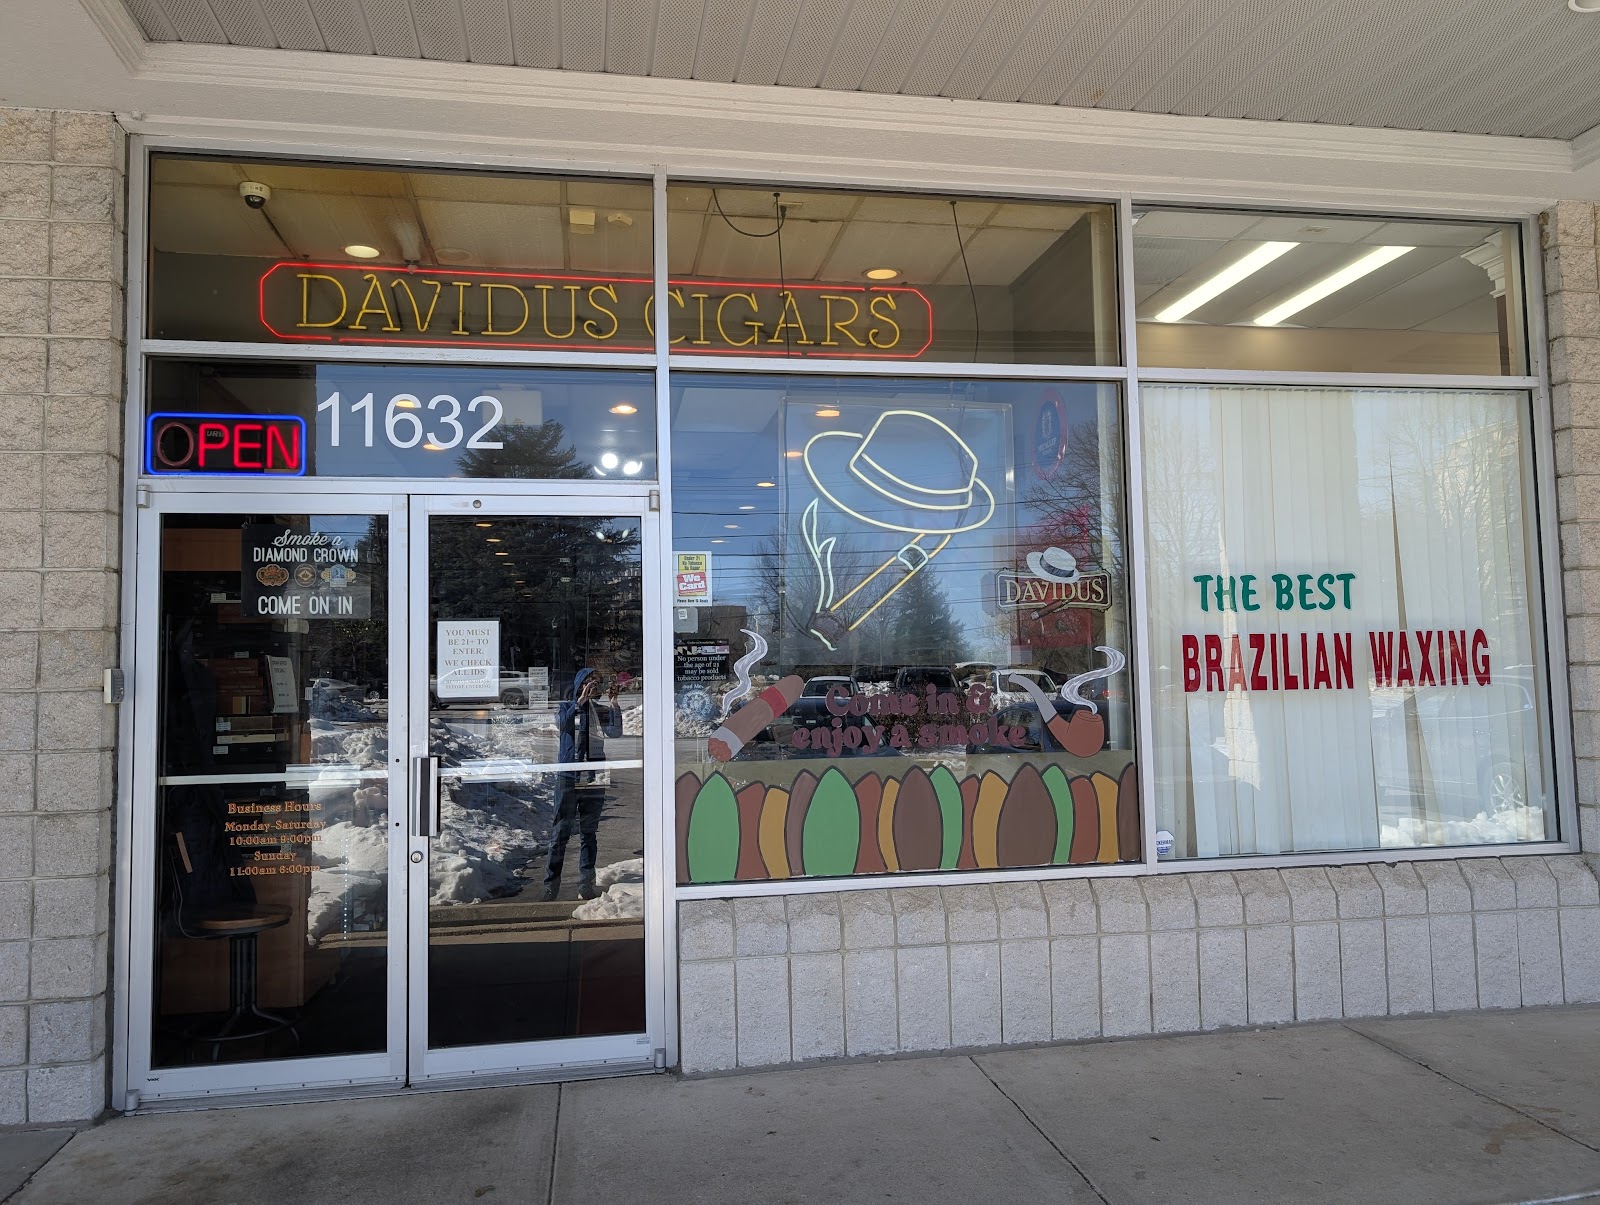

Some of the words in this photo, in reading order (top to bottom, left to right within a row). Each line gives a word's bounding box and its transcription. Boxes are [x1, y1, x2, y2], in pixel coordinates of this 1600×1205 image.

[295, 273, 619, 339] DAVIDUS
[644, 288, 901, 349] CIGARS
[317, 391, 504, 450] 11632
[156, 422, 299, 468] OPEN
[271, 529, 329, 547] Smoke
[331, 535, 344, 546] a
[253, 547, 308, 562] DIAMOND
[313, 548, 359, 562] CROWN
[679, 581, 706, 590] Card
[682, 574, 701, 582] We
[1004, 577, 1105, 603] DAVIDUS
[1193, 574, 1262, 613] THE
[1271, 572, 1356, 611] BEST
[257, 595, 301, 615] COME
[309, 595, 330, 615] ON
[338, 595, 353, 615] IN
[1181, 632, 1355, 692] BRAZILIAN
[1368, 628, 1492, 688] WAXING
[471, 668, 485, 676] IDS
[700, 674, 727, 682] products
[825, 685, 920, 717] Come
[925, 683, 960, 716] in
[965, 683, 994, 714] &
[791, 717, 886, 757] enjoy
[889, 724, 912, 748] a
[917, 716, 1028, 748] smoke
[228, 803, 282, 814] Business
[284, 801, 322, 812] Hours
[224, 819, 327, 832] Monday-Saturday
[229, 836, 278, 846] 10:00am
[280, 834, 322, 845] 9:00pm
[253, 850, 297, 861] Sunday
[229, 866, 277, 877] 11:00am
[279, 865, 320, 876] 6:00pm
